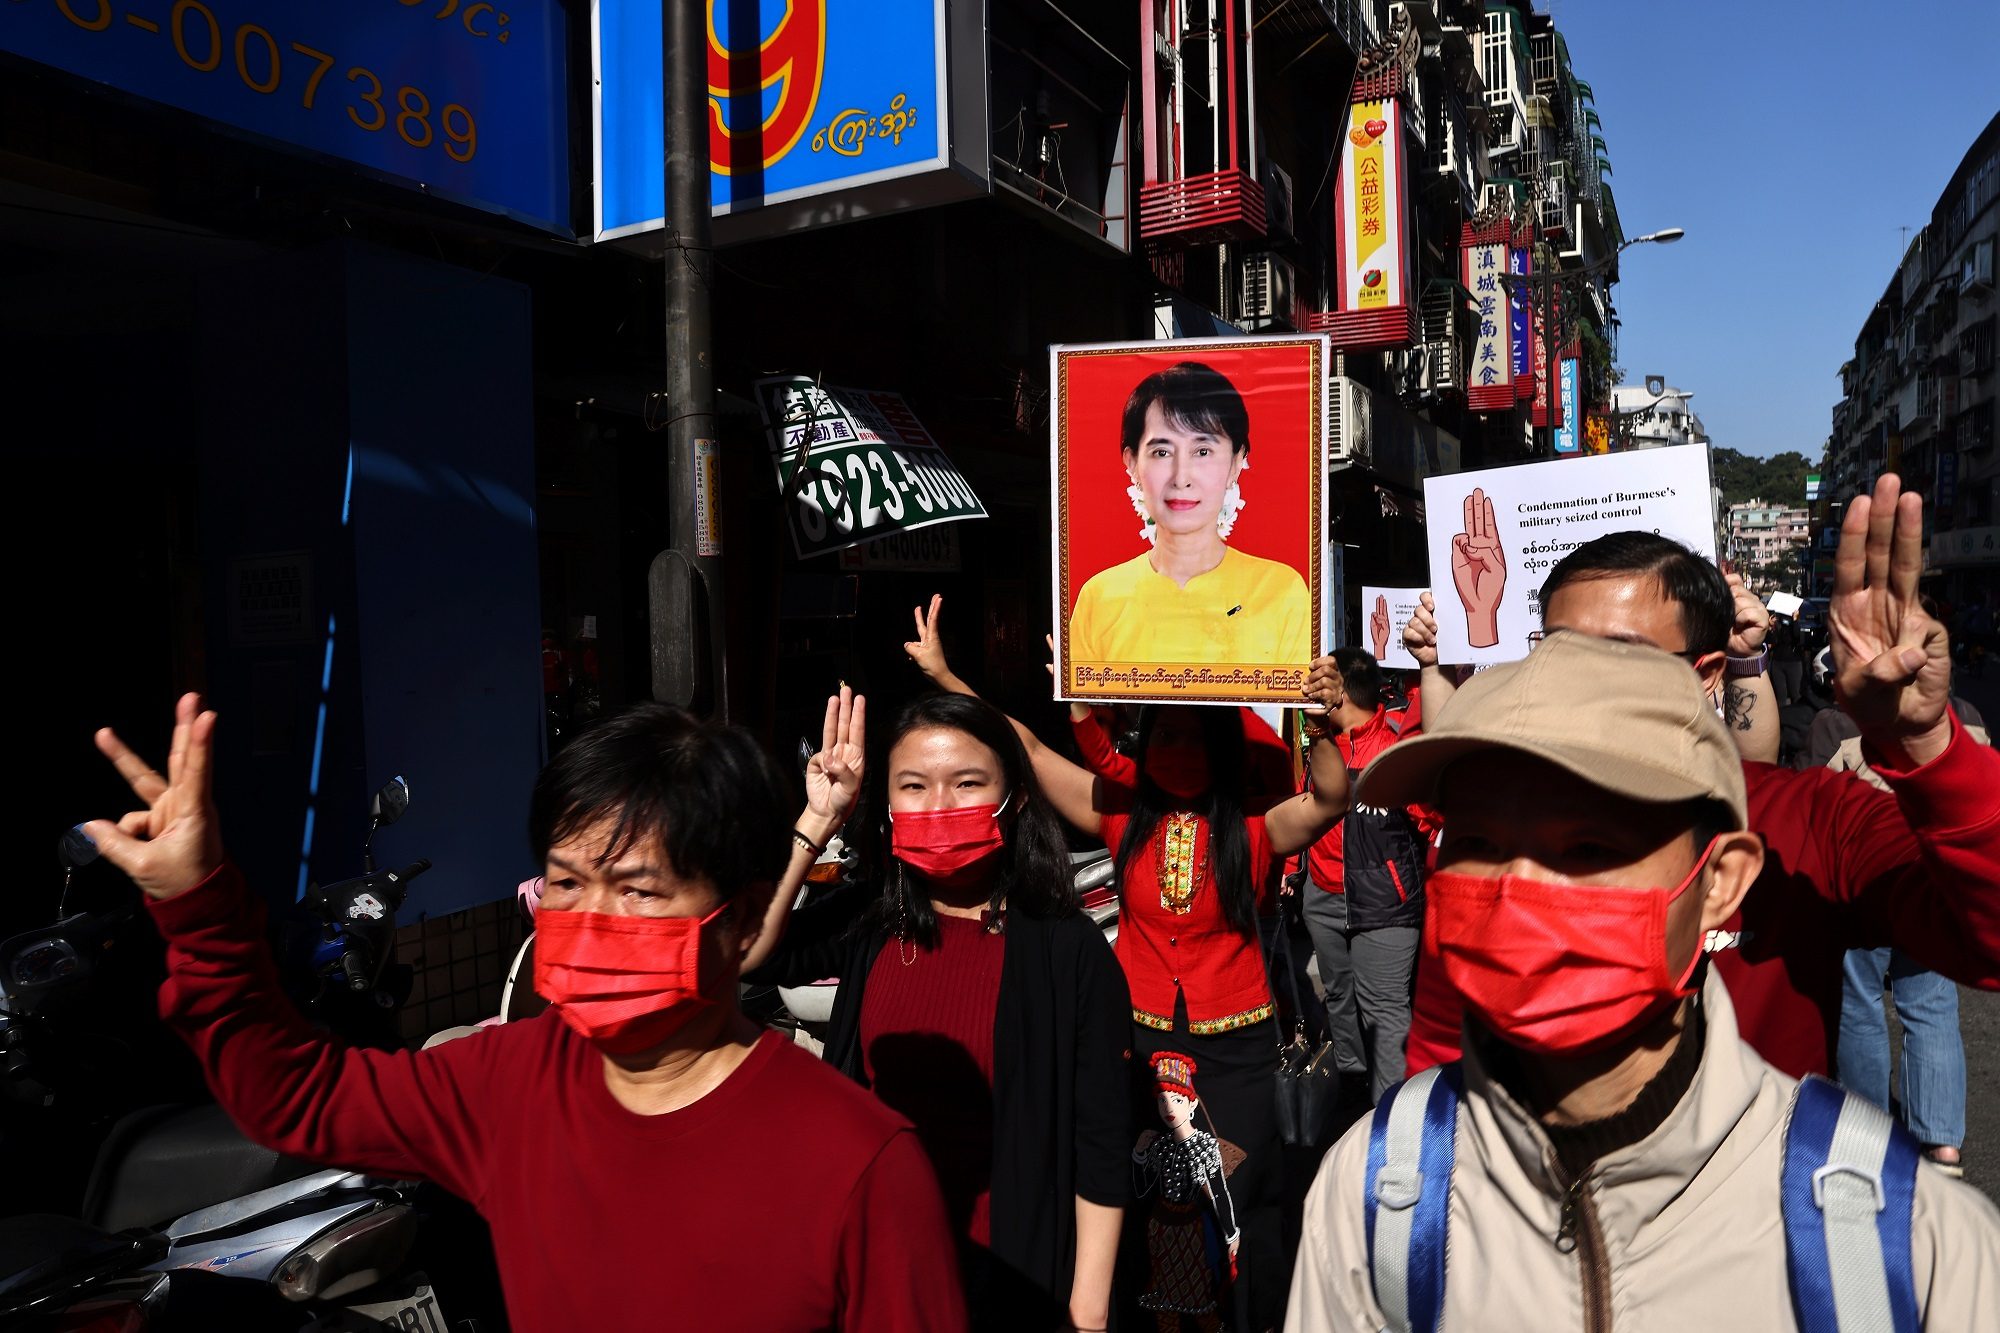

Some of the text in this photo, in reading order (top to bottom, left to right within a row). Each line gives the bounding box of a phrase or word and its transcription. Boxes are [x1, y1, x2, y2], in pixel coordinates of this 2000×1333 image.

[8, 0, 477, 163] -007389
[1360, 157, 1380, 236] 公益彩券
[1477, 249, 1499, 385] 滇城雲南美食
[786, 421, 850, 446] 不動產
[796, 450, 977, 543] 8923-5000
[1517, 486, 1676, 514] Condemnation of Burmese's
[1519, 505, 1642, 529] military seized control
